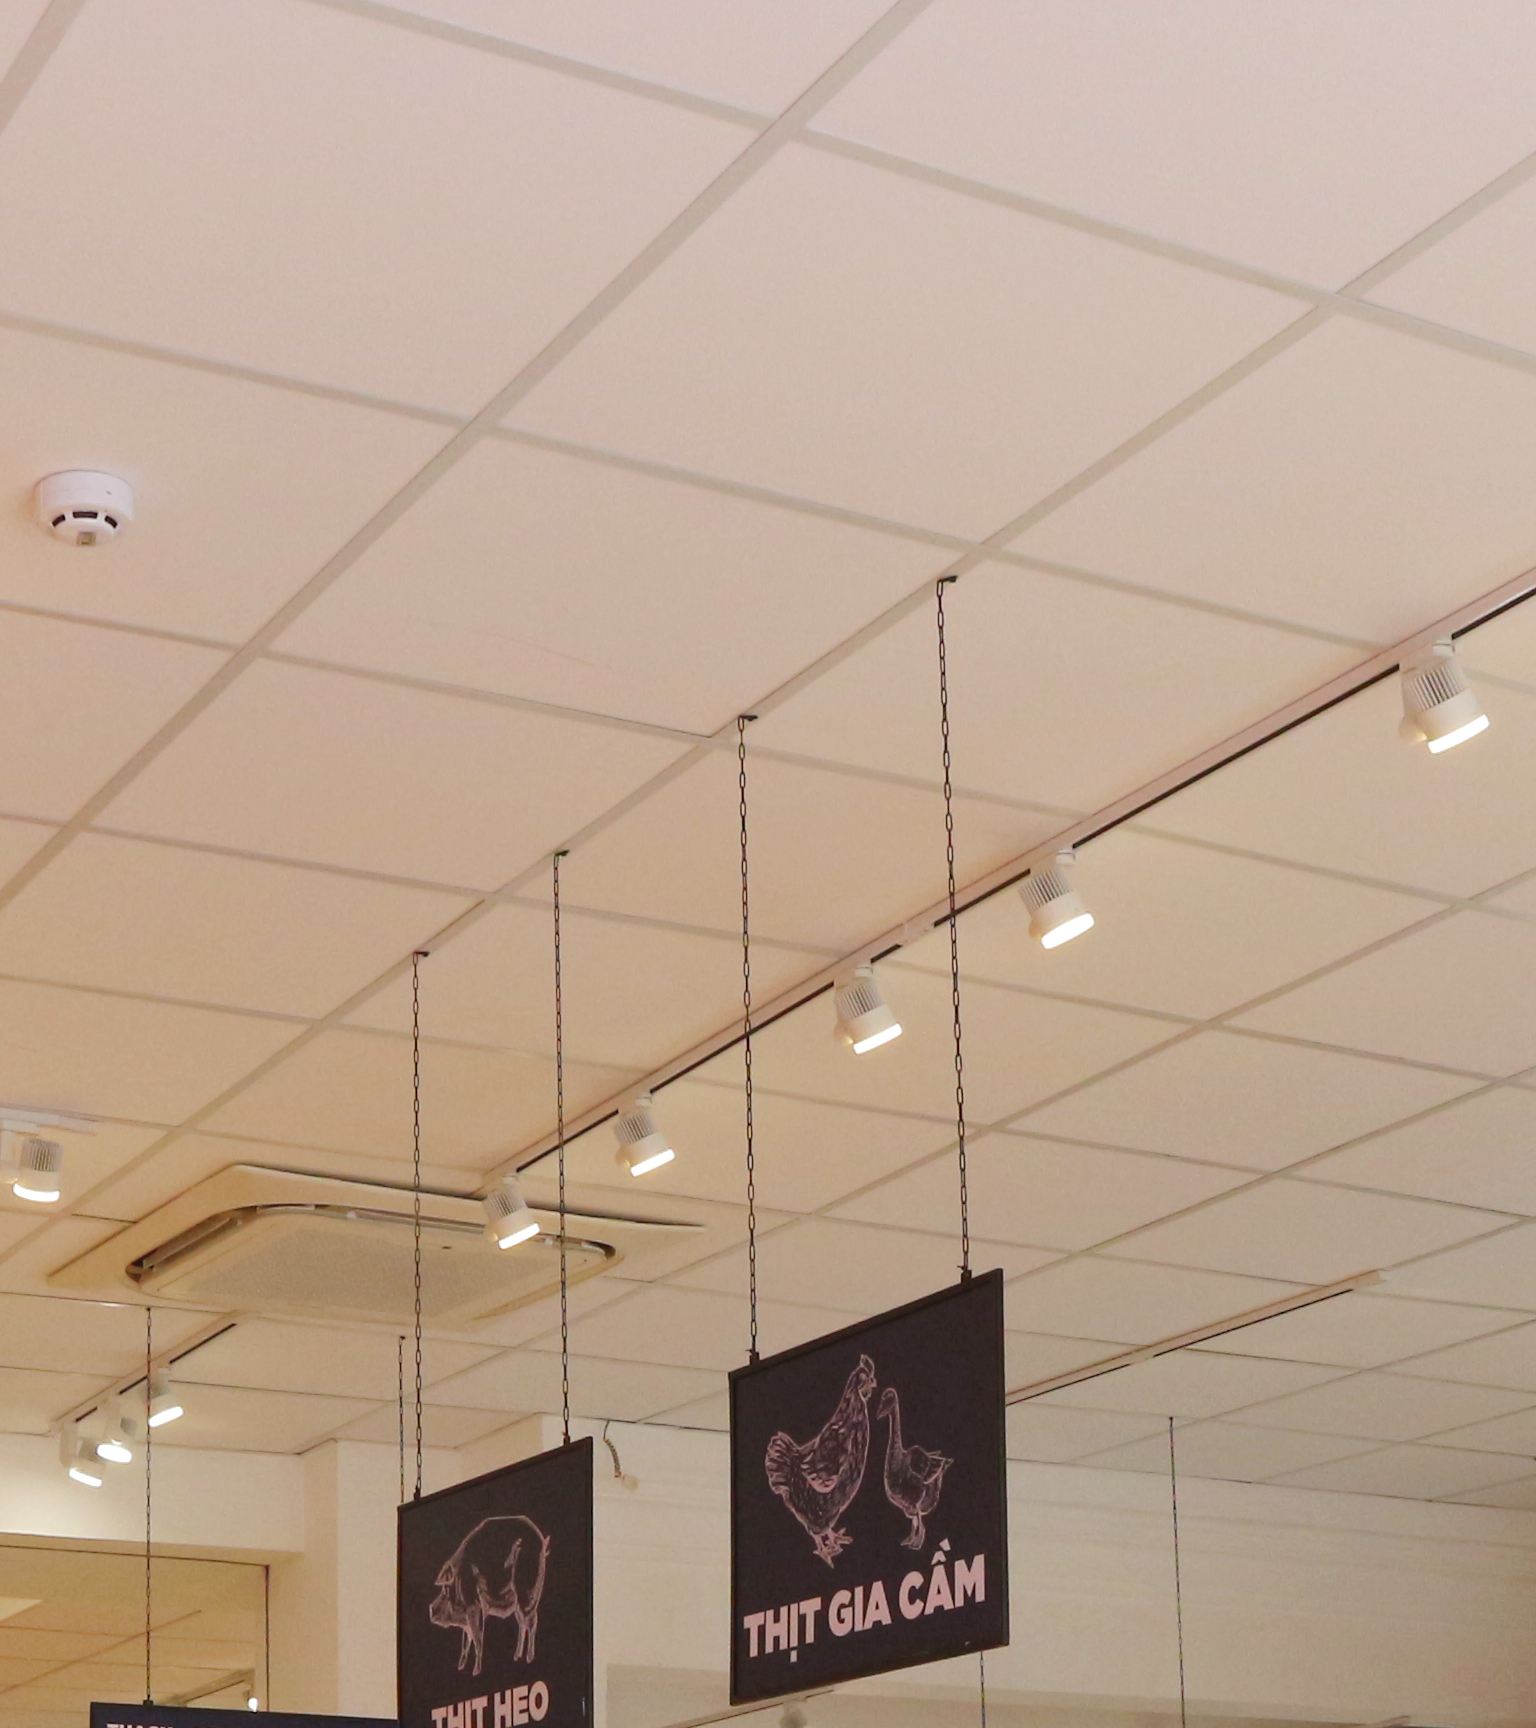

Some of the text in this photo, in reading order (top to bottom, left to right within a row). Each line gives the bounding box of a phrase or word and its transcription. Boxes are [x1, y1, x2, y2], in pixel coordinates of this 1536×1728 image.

[743, 1538, 986, 1662] THỊT GIA CẦM
[494, 1681, 549, 1728] HEO
